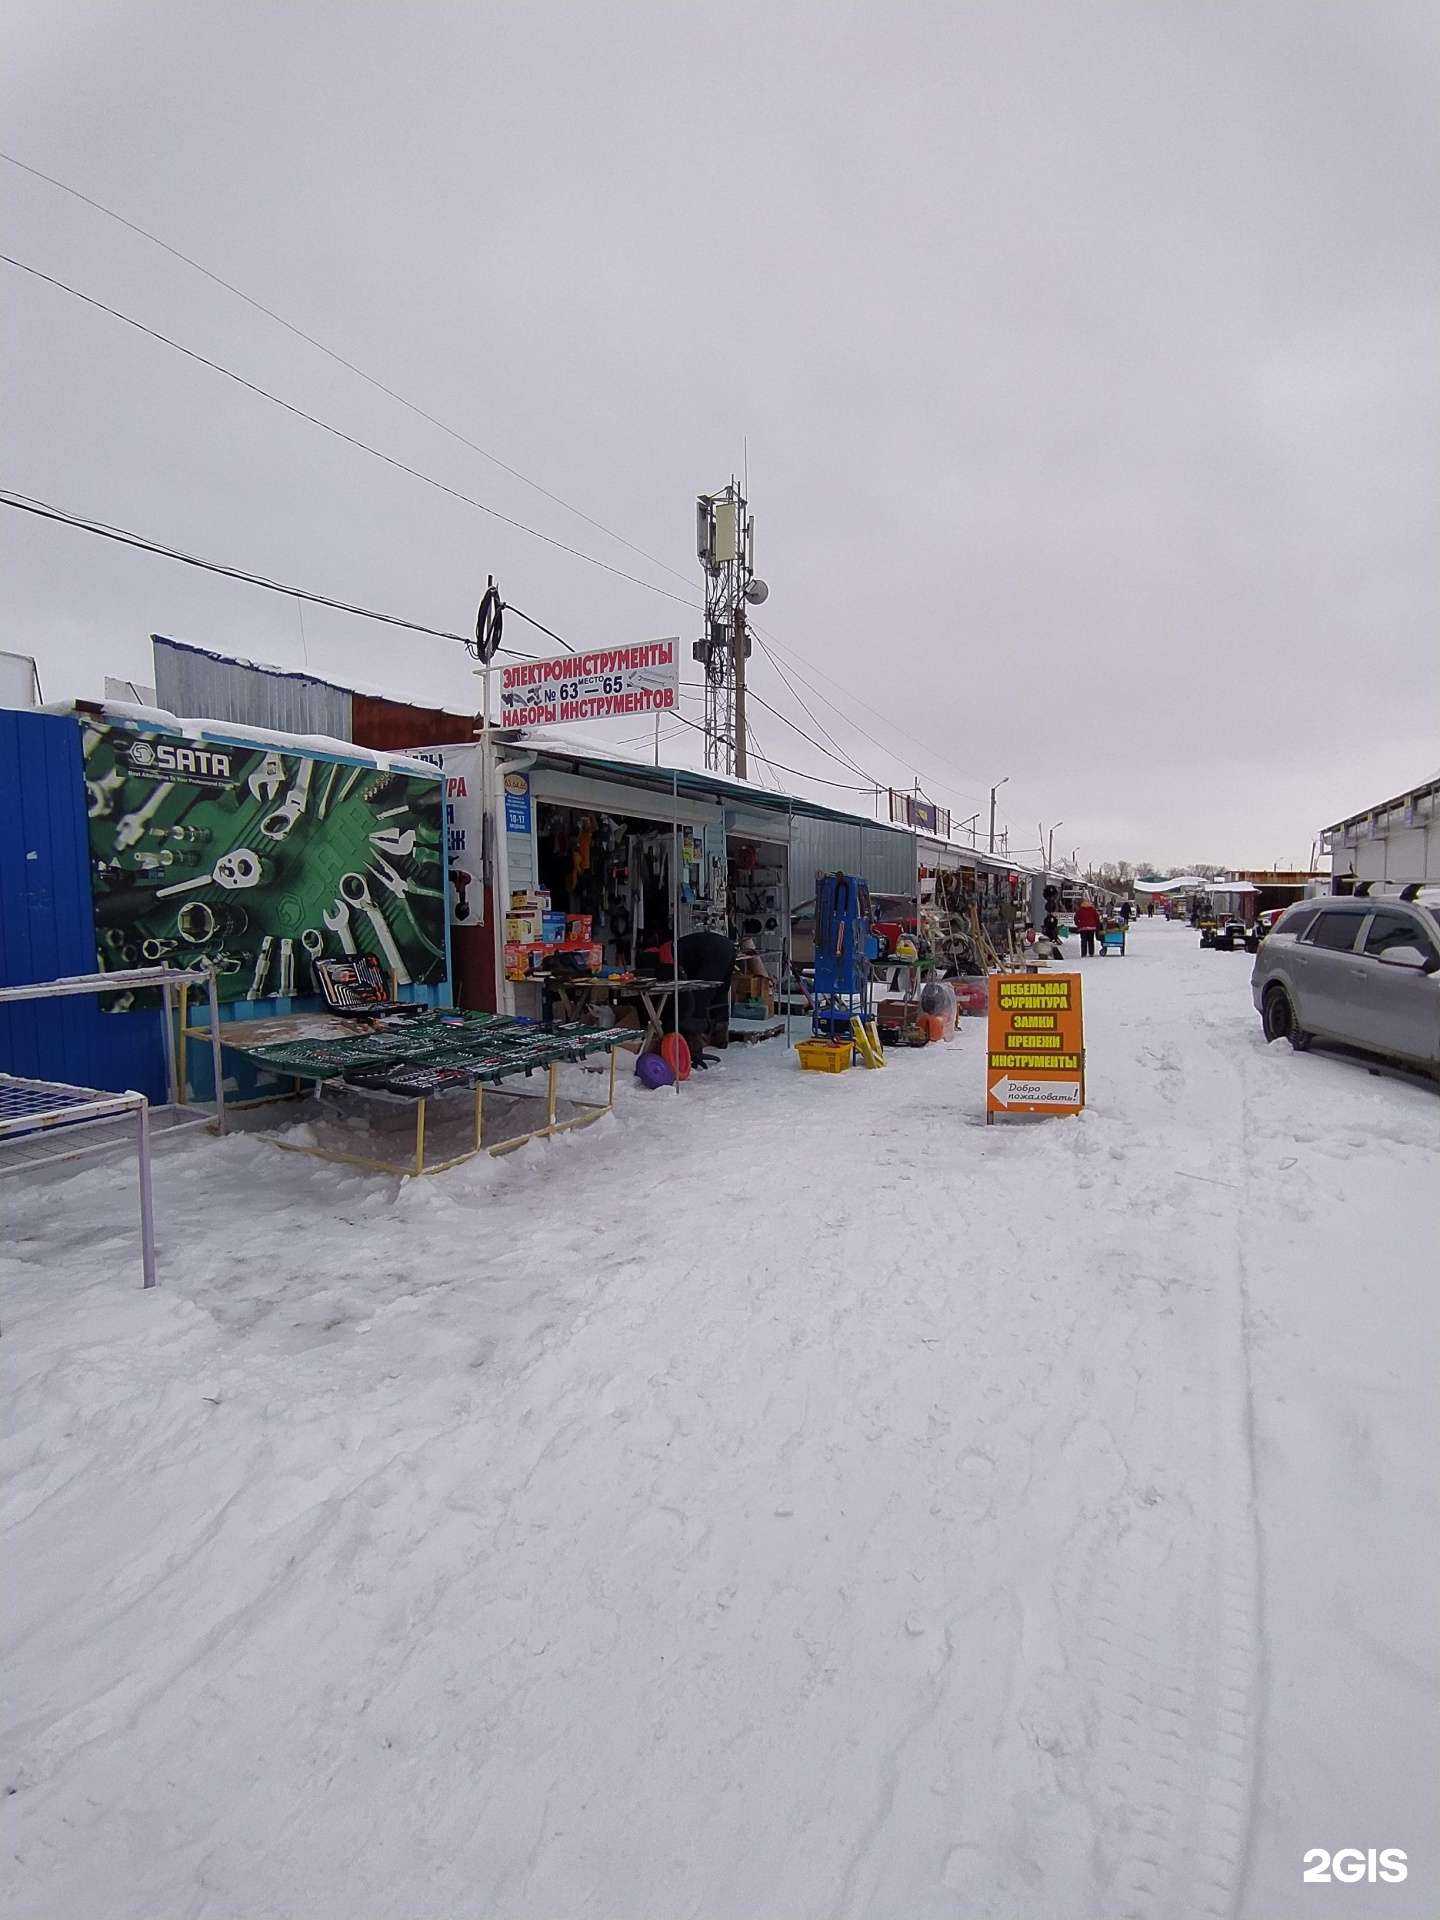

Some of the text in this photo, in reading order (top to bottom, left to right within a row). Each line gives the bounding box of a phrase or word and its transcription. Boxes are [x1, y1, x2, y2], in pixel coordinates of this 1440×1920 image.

[502, 641, 673, 689] ЭЛЕКТРОИНСТРУМЕНТЫ
[577, 675, 604, 685] МЕСТО
[544, 688, 556, 703] №
[559, 682, 579, 700] 63
[602, 675, 623, 695] 65
[502, 687, 674, 728] НАБОРЫ ИНСТРУМЕНТОВ
[156, 745, 230, 777] SATA
[1000, 983, 1068, 995] МЕБЕЛЬНАЯ
[1000, 996, 1068, 1008] ФУРНИТУРА
[1013, 1015, 1054, 1028] ЗАМКИ
[1007, 1035, 1060, 1048] КРЕПЕЖИ
[991, 1054, 1078, 1068] ИНСТРУМЕНТЫ
[1007, 1088, 1078, 1101] пожаловать!
[1008, 1083, 1041, 1094] Добро
